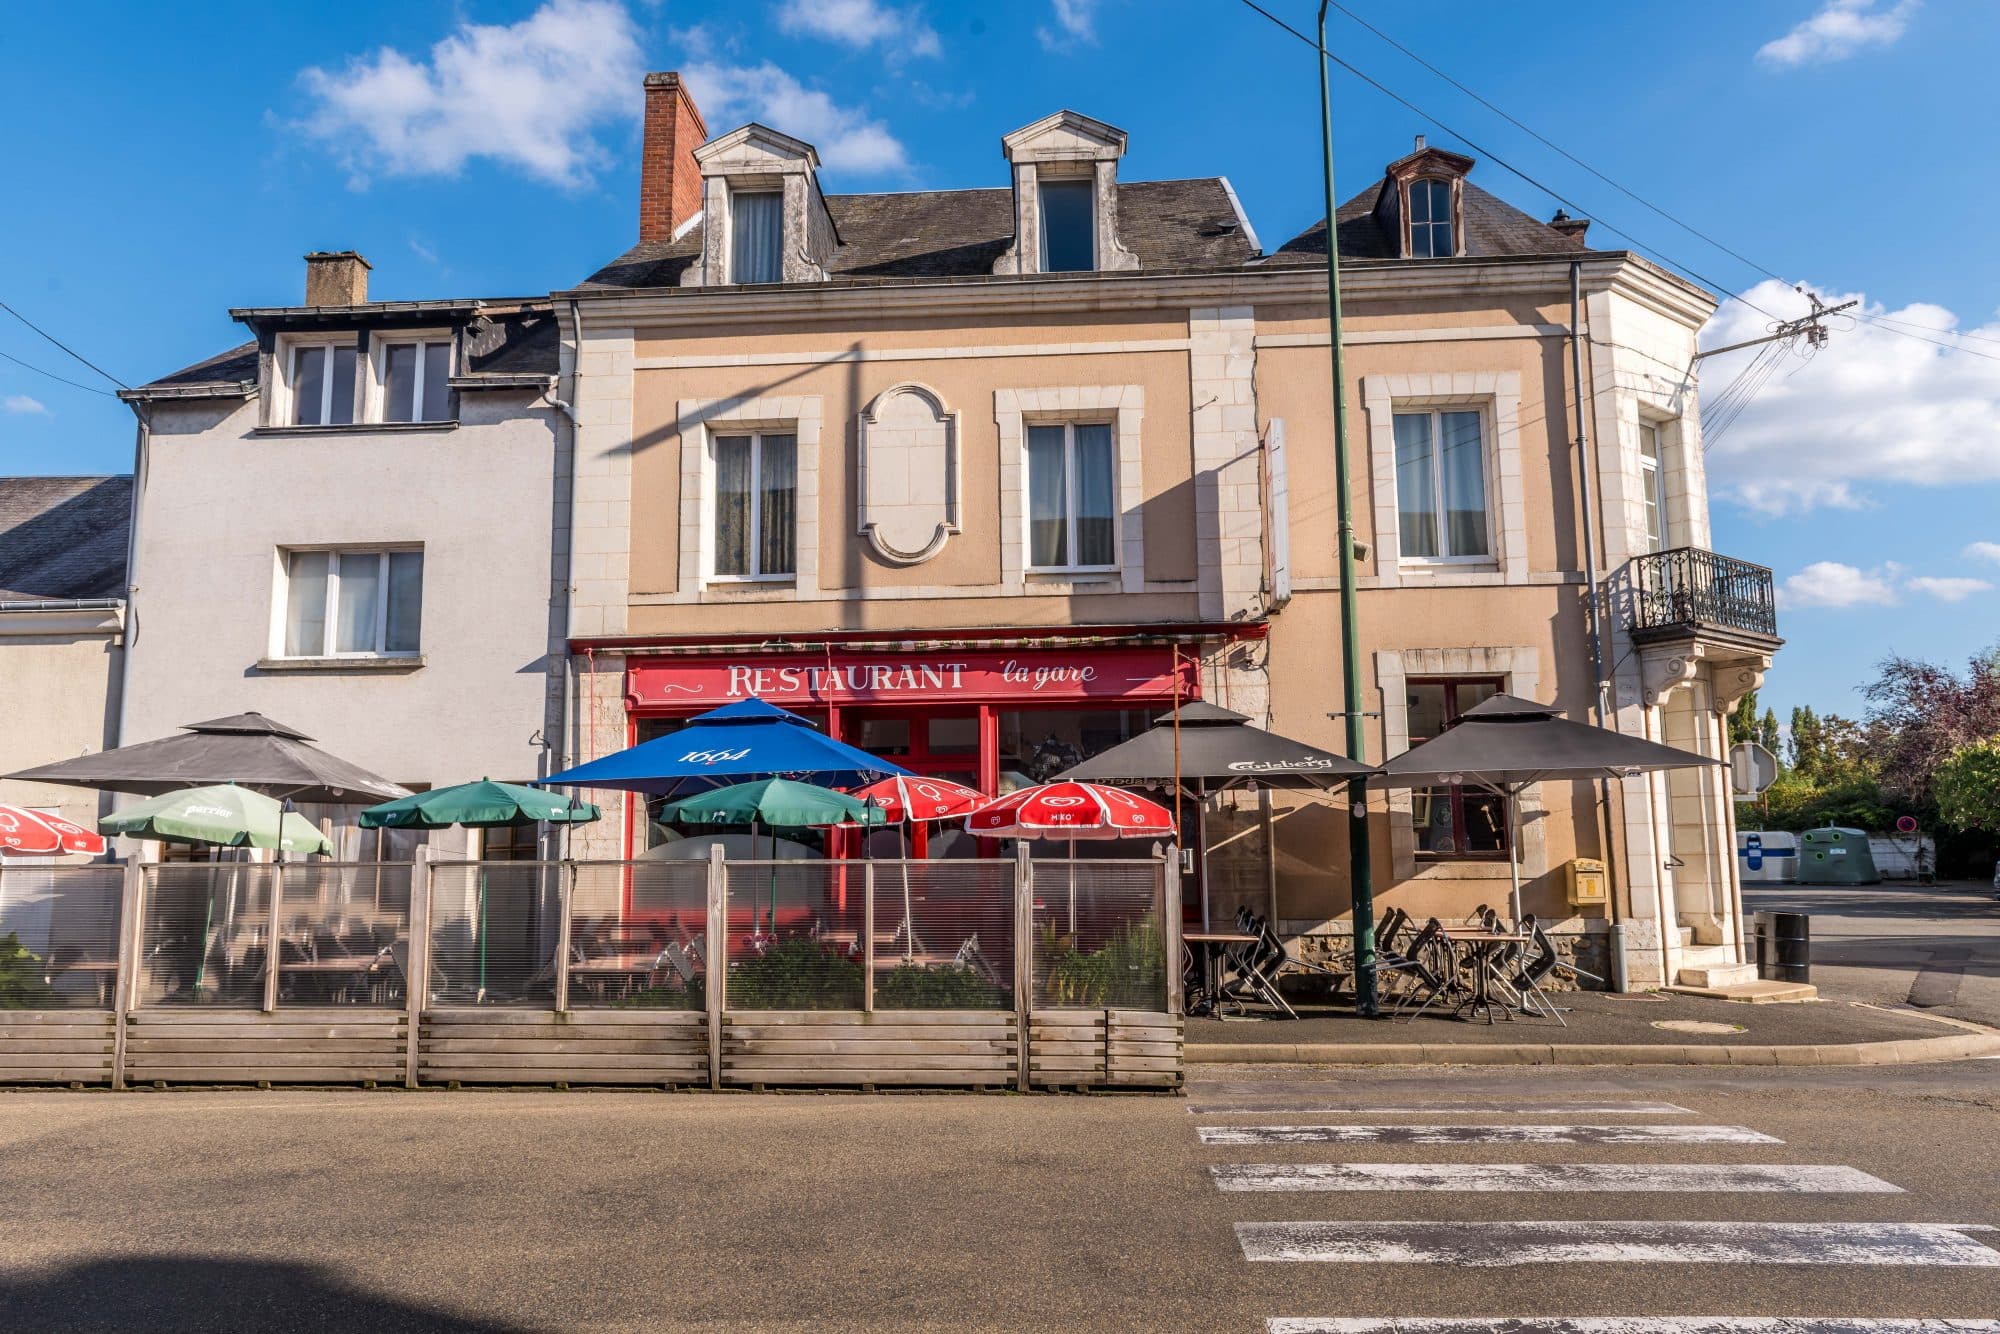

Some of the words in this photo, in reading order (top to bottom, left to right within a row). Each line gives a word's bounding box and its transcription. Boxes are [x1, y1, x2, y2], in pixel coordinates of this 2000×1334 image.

[727, 663, 967, 696] RESTAURANT
[1003, 659, 1028, 683] la
[1033, 665, 1098, 691] gare
[678, 748, 752, 763] 1664
[1228, 757, 1333, 772] Carlsberg
